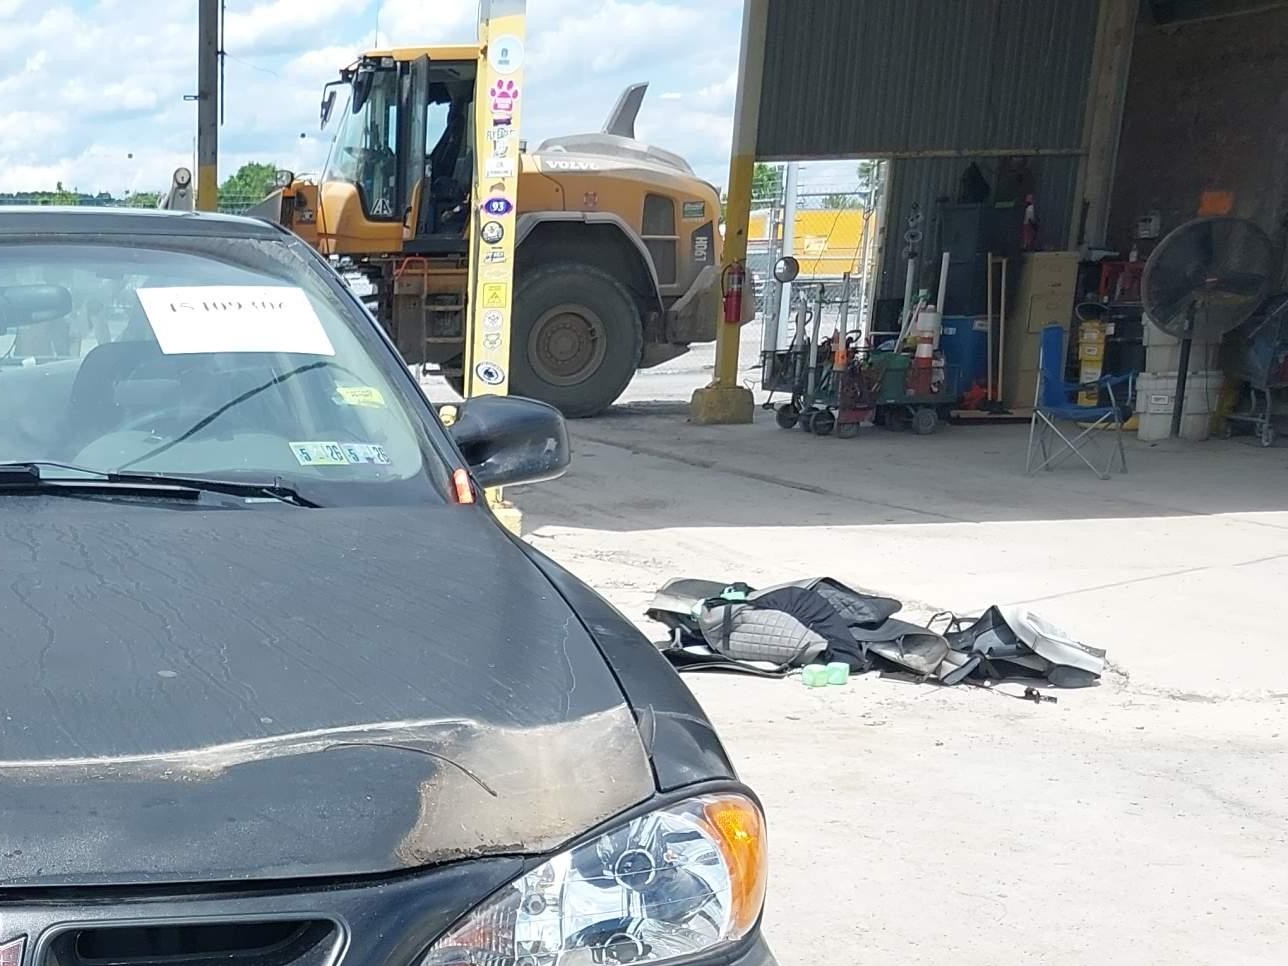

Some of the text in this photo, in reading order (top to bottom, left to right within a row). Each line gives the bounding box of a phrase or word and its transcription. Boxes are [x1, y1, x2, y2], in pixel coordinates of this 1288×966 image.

[694, 236, 709, 261] L90H
[299, 444, 345, 462] 5 26
[347, 448, 360, 462] 5
